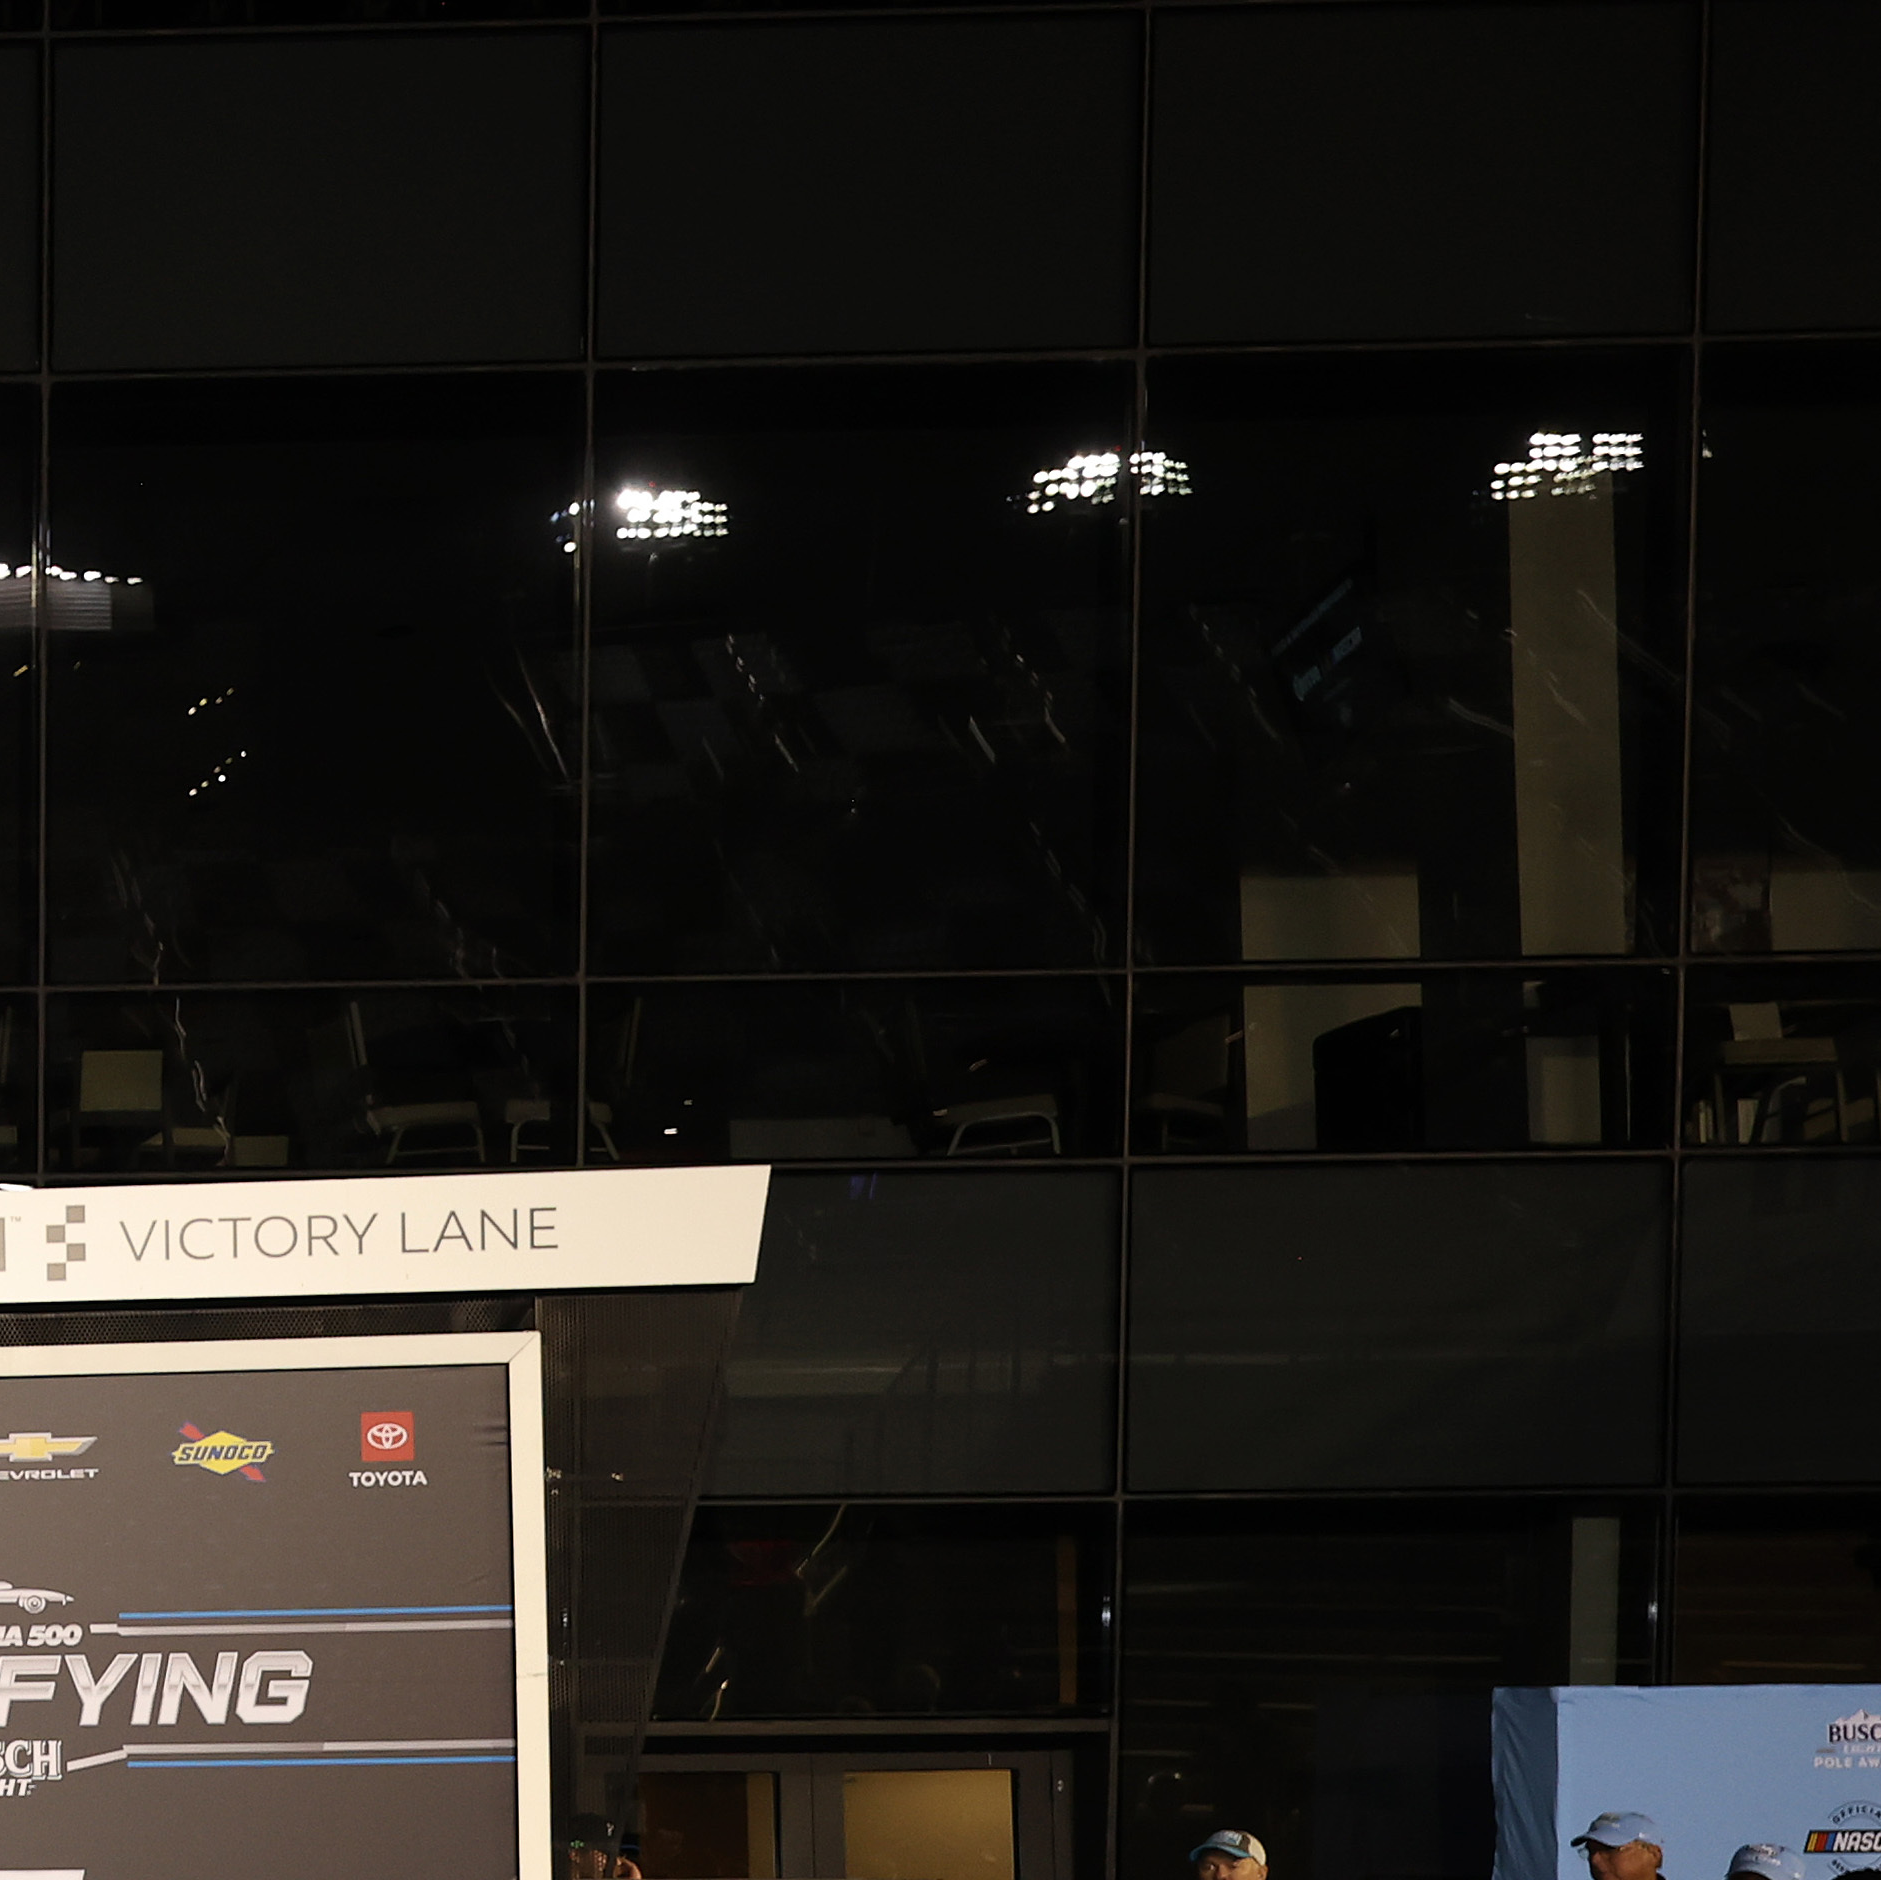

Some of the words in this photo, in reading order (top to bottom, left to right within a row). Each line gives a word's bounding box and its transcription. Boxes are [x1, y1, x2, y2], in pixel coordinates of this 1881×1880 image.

[120, 1214, 379, 1264] VICTORY
[399, 1207, 560, 1253] LANE
[177, 1442, 271, 1462] SUNOCO
[350, 1471, 427, 1486] TOYOTA
[30, 1624, 83, 1645] 500
[1814, 1757, 1853, 1768] POLE
